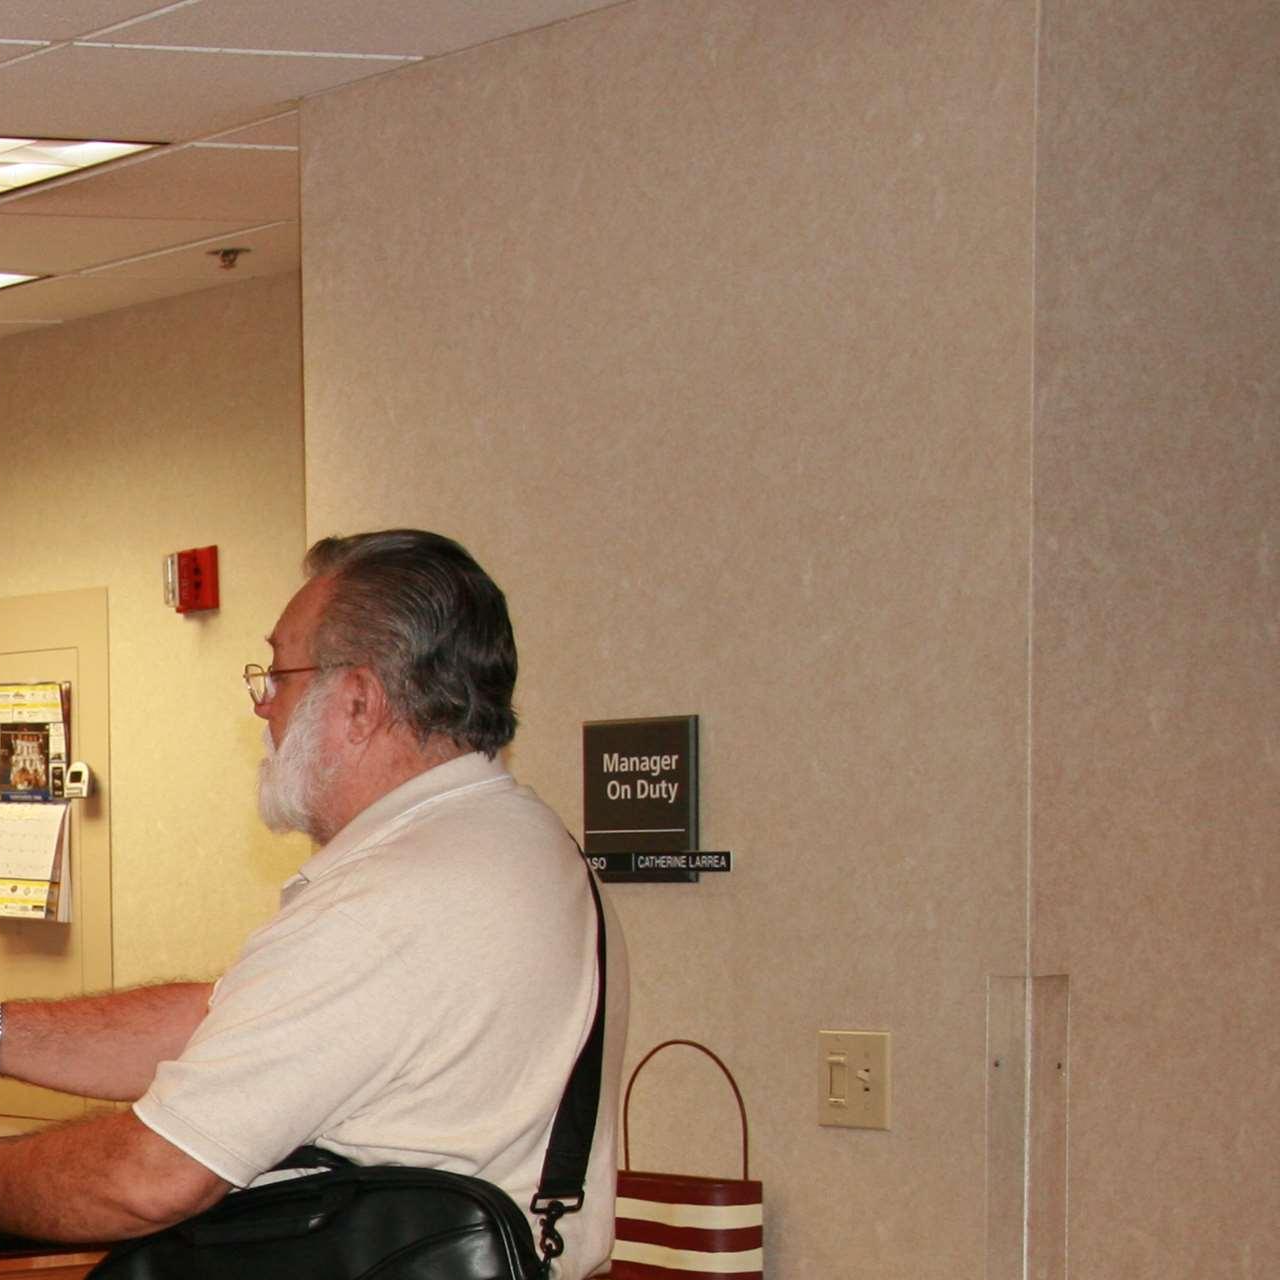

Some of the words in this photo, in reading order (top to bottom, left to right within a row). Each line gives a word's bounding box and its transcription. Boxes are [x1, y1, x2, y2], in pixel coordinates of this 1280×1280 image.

[602, 752, 679, 776] Manager
[606, 780, 631, 800] On
[636, 779, 679, 803] Duty
[587, 856, 607, 870] SO
[637, 855, 687, 869] CATHERINE
